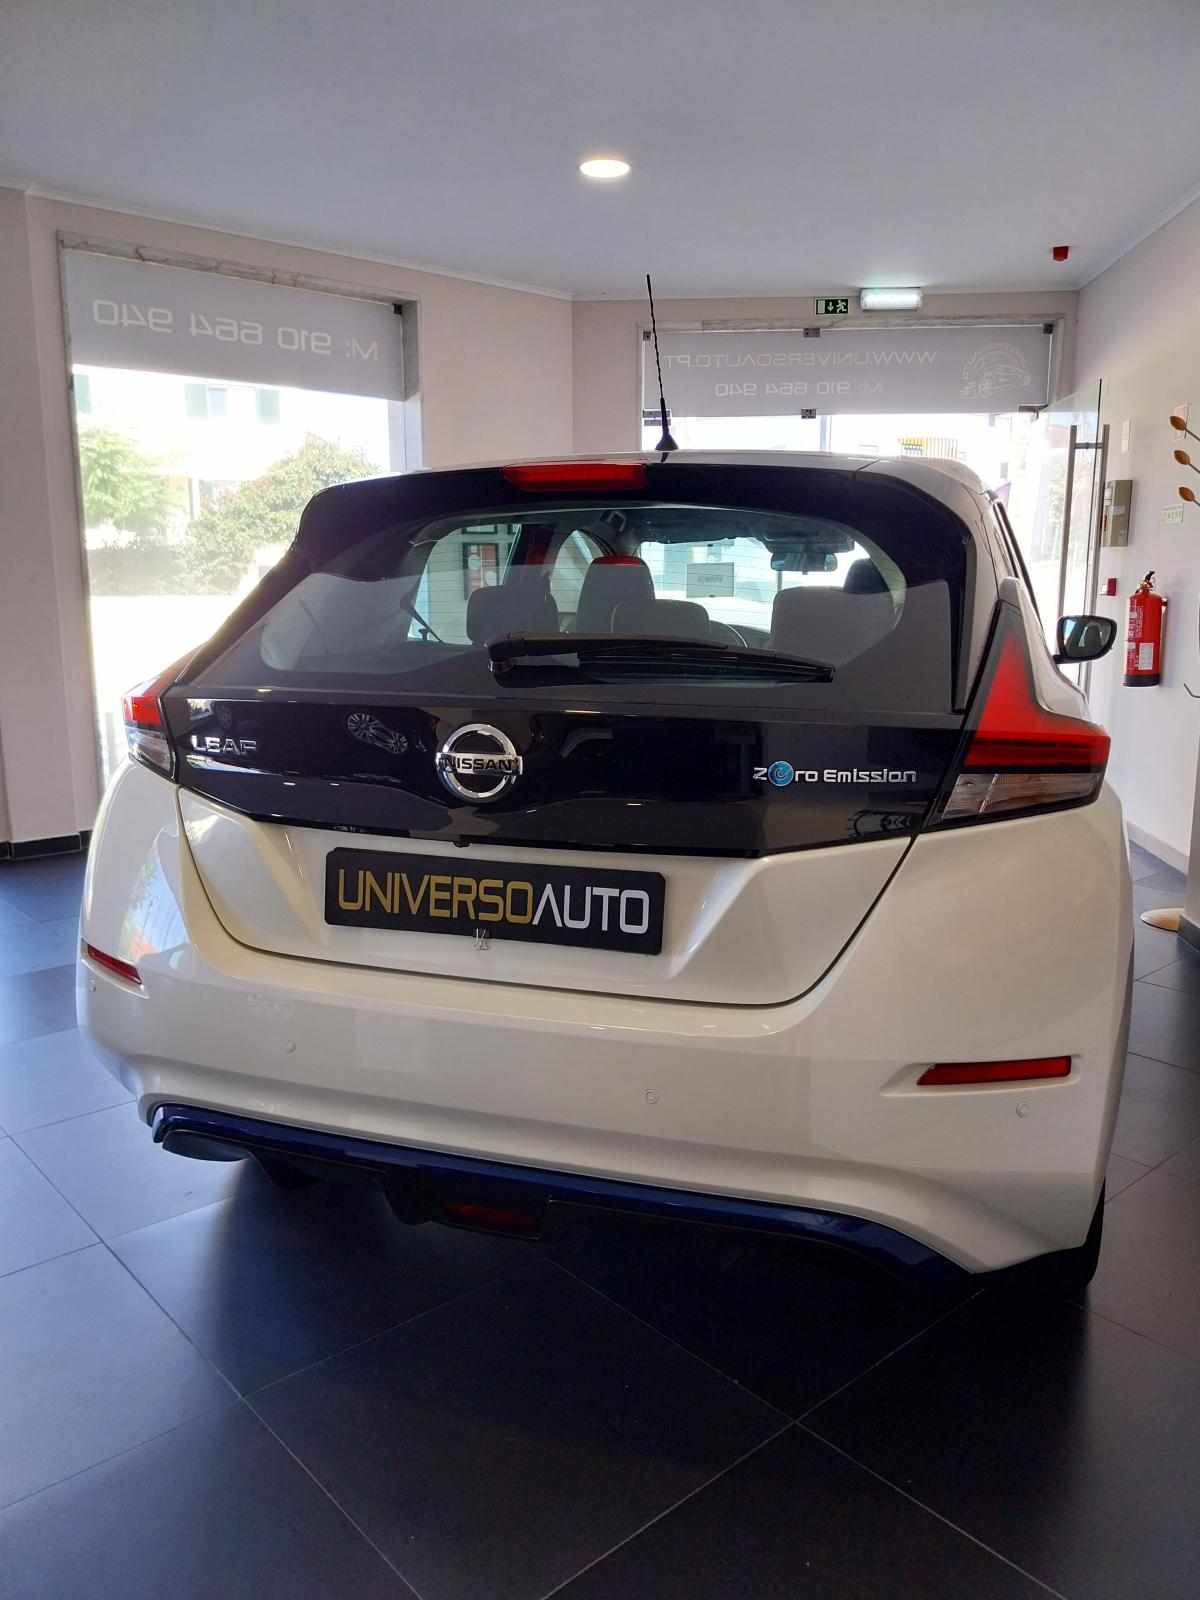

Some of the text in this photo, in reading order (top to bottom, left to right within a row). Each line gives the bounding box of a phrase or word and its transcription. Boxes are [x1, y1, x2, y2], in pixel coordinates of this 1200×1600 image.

[191, 735, 256, 755] LEAF
[440, 755, 519, 772] NISSAN
[823, 768, 917, 783] Emission
